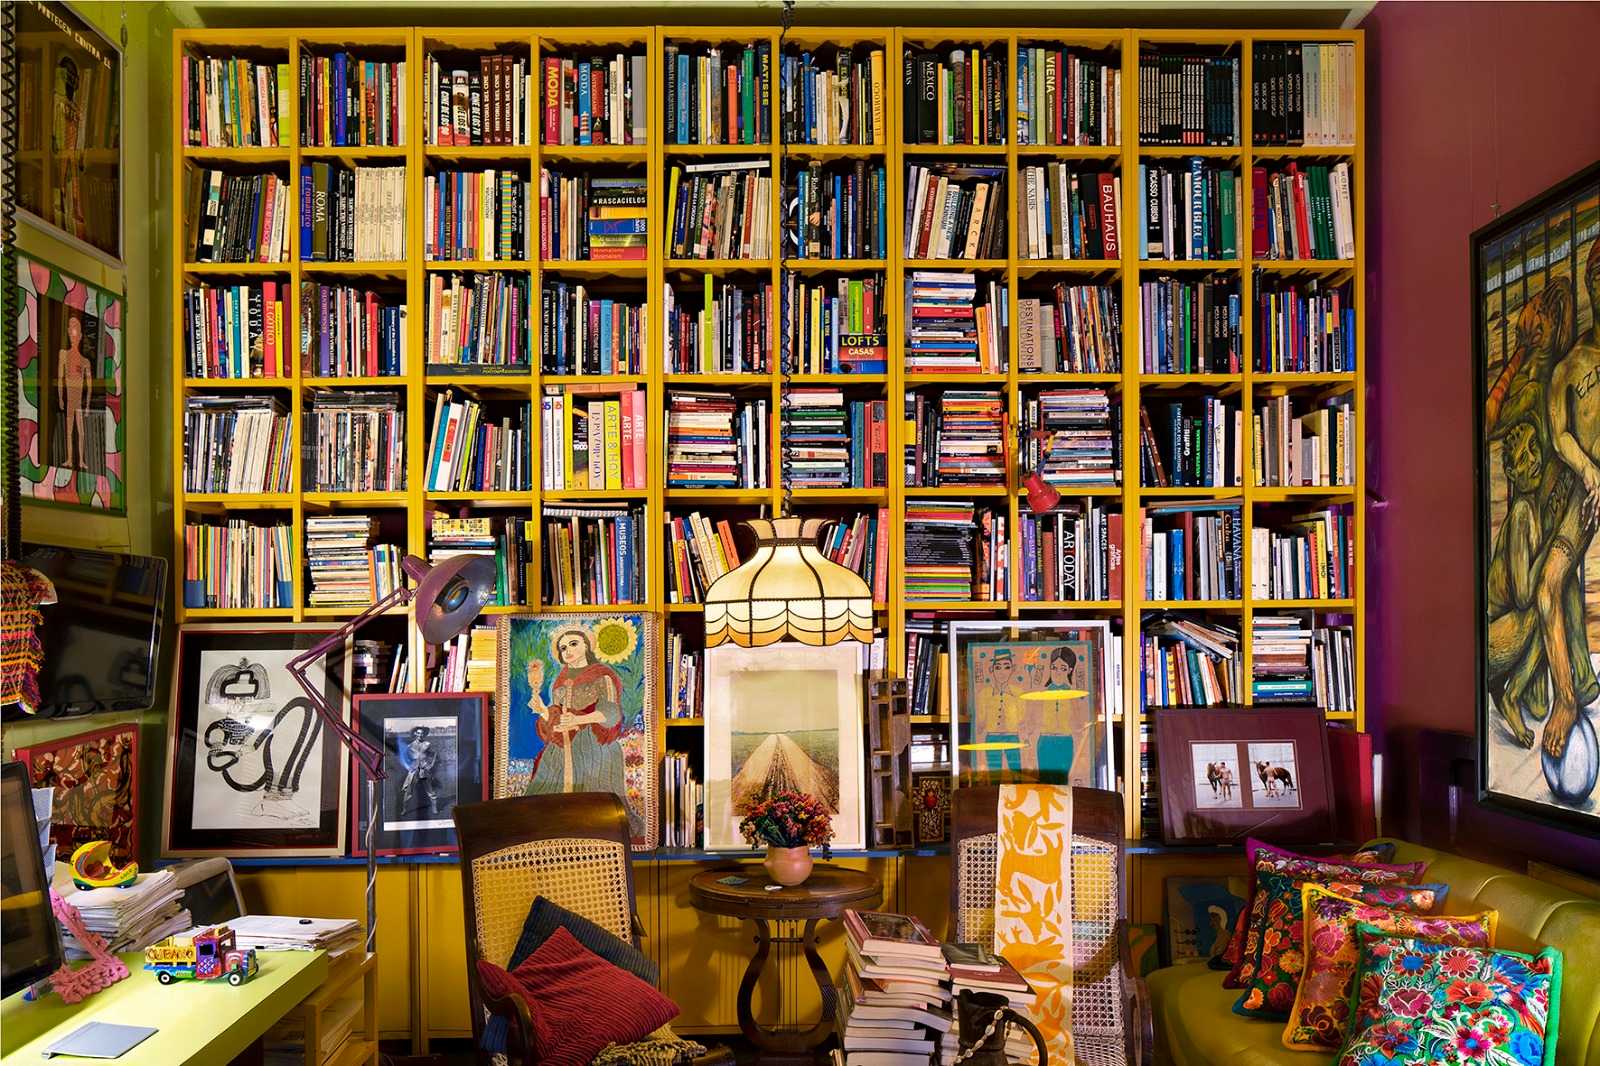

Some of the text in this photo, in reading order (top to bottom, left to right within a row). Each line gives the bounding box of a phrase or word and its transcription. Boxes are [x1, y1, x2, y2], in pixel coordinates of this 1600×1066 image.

[74, 32, 100, 61] CONTRA
[548, 66, 558, 107] MODA
[1046, 56, 1055, 93] VIENA
[441, 115, 450, 126] LOS
[472, 115, 480, 126] LOS
[316, 191, 325, 222] ROMA
[1102, 185, 1115, 251] BAUHAUS
[1193, 211, 1202, 240] BLEU
[266, 301, 274, 309] EL
[842, 336, 879, 345] LOFTS
[636, 415, 644, 438] ARTE
[608, 405, 618, 479] ARTE HOY
[1233, 518, 1241, 560] HAVANA
[146, 948, 193, 962] CUBANO
